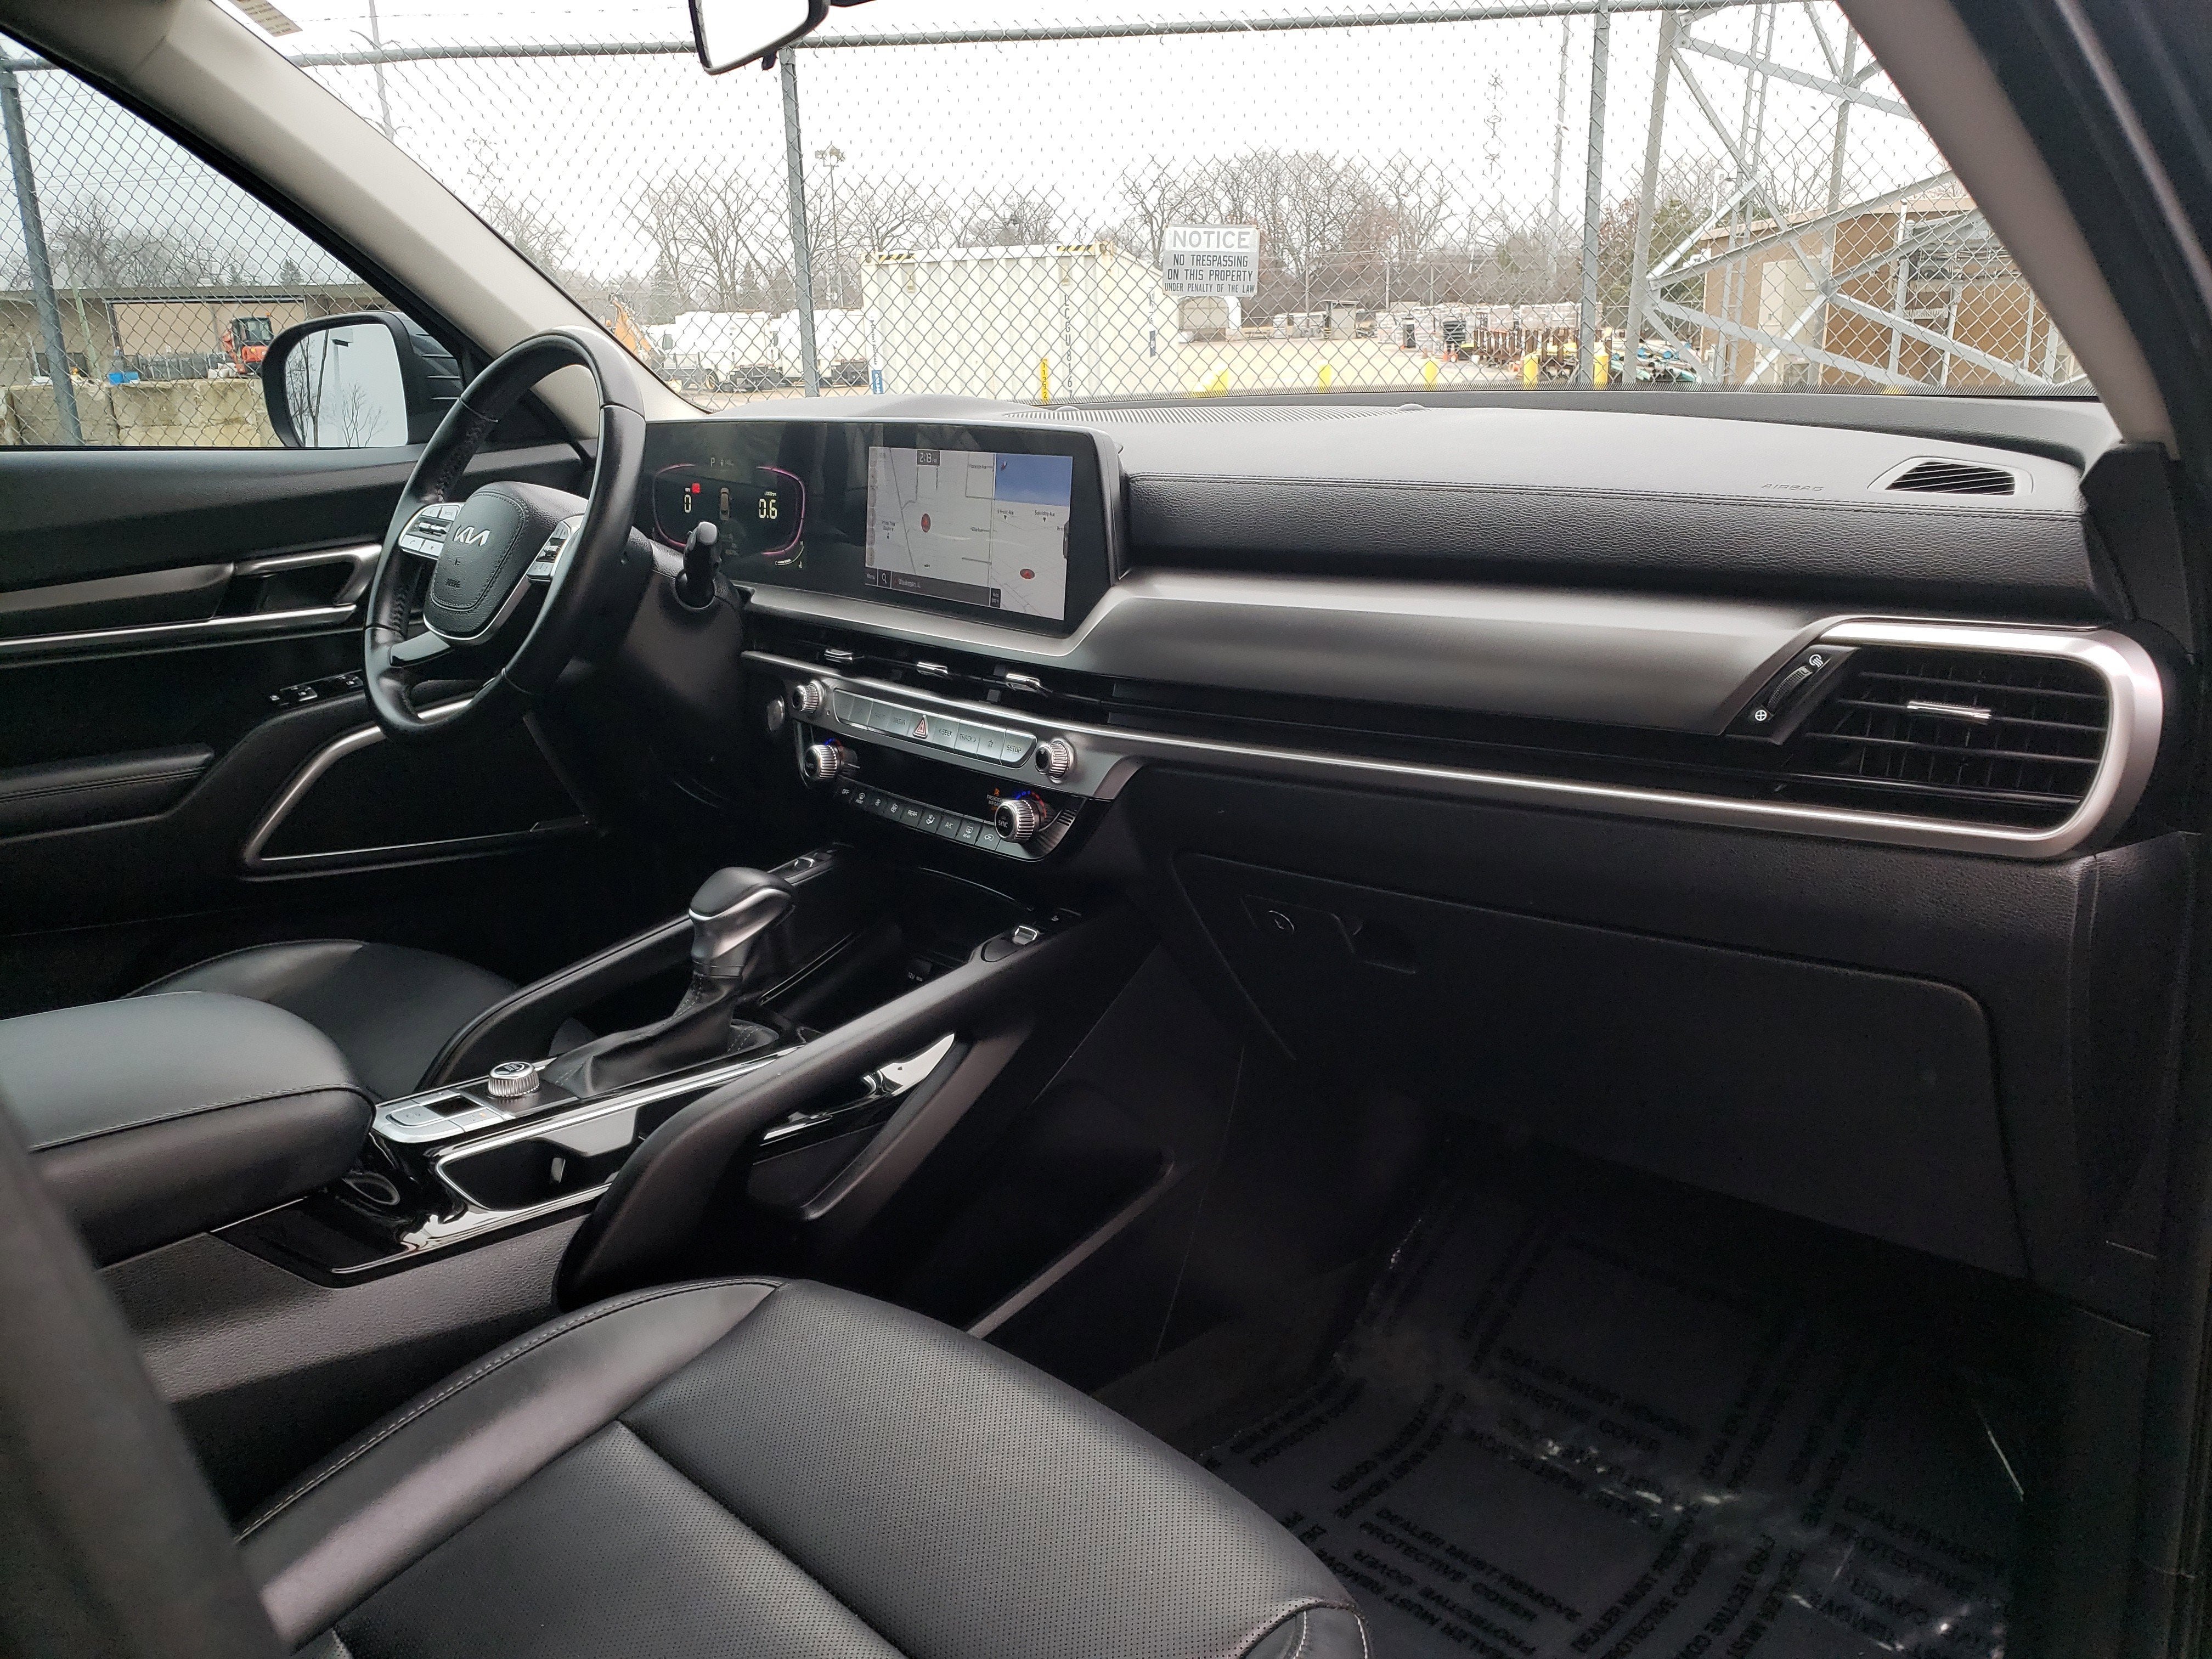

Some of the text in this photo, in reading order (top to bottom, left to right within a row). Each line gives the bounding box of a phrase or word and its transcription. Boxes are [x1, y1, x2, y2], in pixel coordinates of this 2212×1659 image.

[1173, 230, 1250, 249] NOTICE
[1173, 253, 1249, 267] NO TRESPASSING
[1167, 268, 1254, 282] ON THIS PROPERTY
[1164, 283, 1255, 294] UNDER PENALTY OF THE LAW
[919, 453, 932, 463] 2:13
[1760, 483, 1825, 492] AIRBAG
[684, 494, 691, 513] 0
[759, 498, 777, 520] 0.6
[941, 728, 952, 737] SEEK
[1007, 744, 1022, 753] SETUP
[907, 809, 918, 817] REAR
[998, 820, 1009, 828] SYNC
